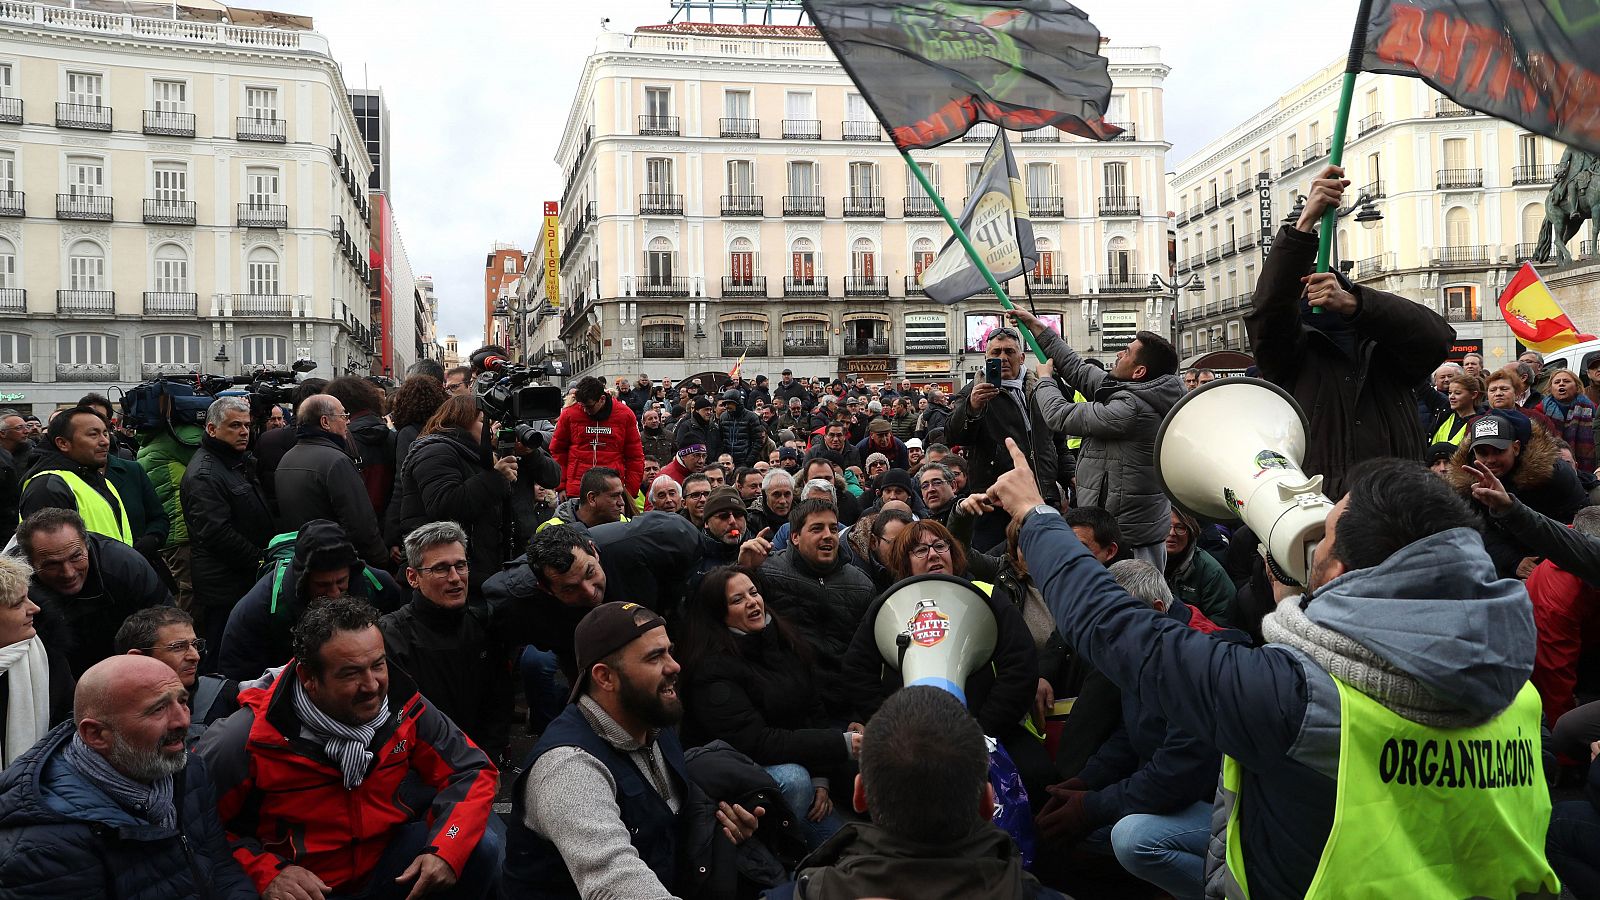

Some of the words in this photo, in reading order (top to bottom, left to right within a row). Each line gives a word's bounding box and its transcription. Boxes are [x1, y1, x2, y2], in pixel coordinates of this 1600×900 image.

[1260, 179, 1271, 228] HOTEL
[547, 218, 556, 278] Lartec
[1263, 235, 1272, 262] EU
[851, 363, 886, 371] PALAZZO
[917, 630, 941, 639] TAXI
[1379, 726, 1535, 789] ORGANIZACIÓN
